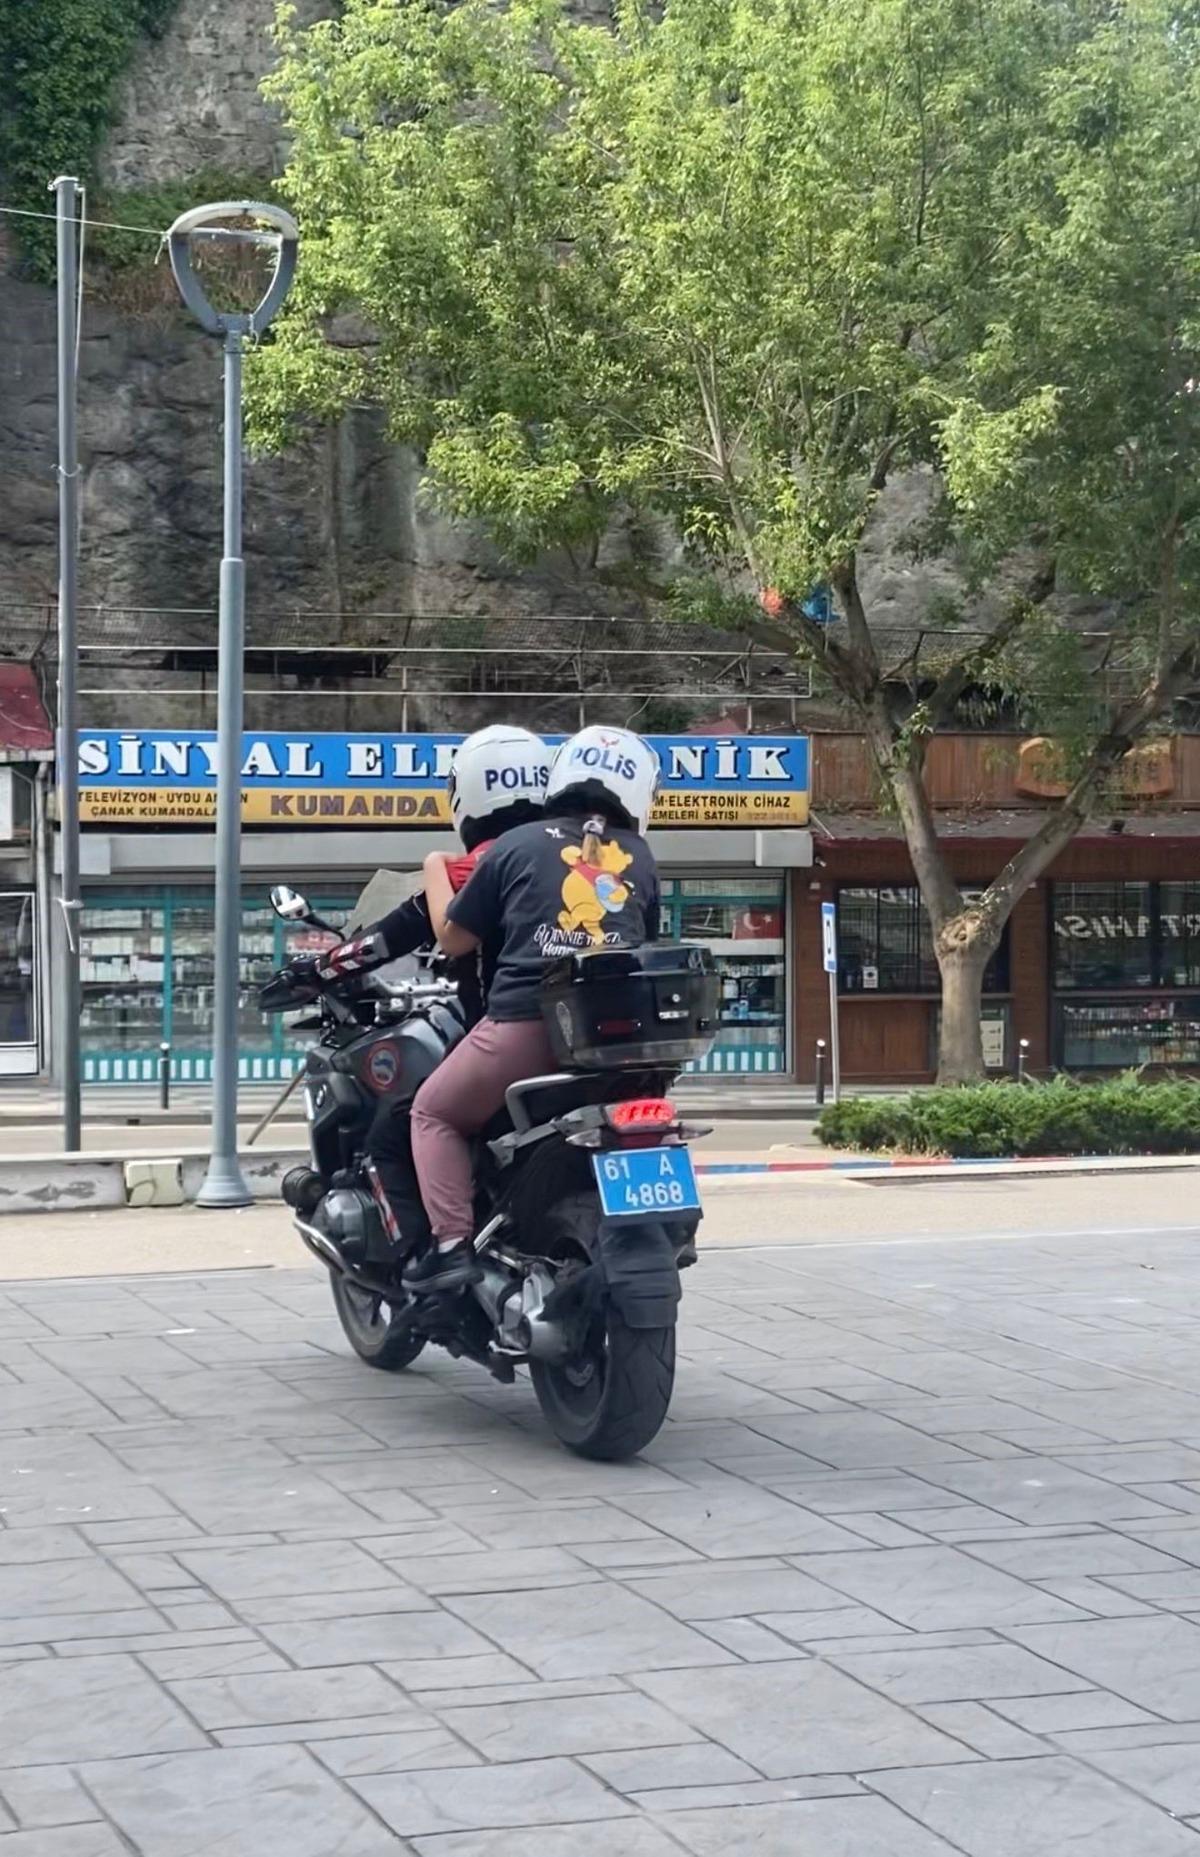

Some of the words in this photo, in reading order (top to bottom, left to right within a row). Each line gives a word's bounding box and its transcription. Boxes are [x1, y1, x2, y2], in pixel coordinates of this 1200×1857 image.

[78, 735, 321, 776] SİNYAL
[166, 793, 201, 804] UYDU
[270, 795, 440, 817] KUMANDA
[754, 793, 790, 808] CİHAZ
[91, 806, 135, 818] ÇANAK
[139, 807, 217, 817] KUMANDALA
[604, 1157, 631, 1181] 61
[660, 1153, 675, 1176] A
[625, 1180, 684, 1208] 4868
